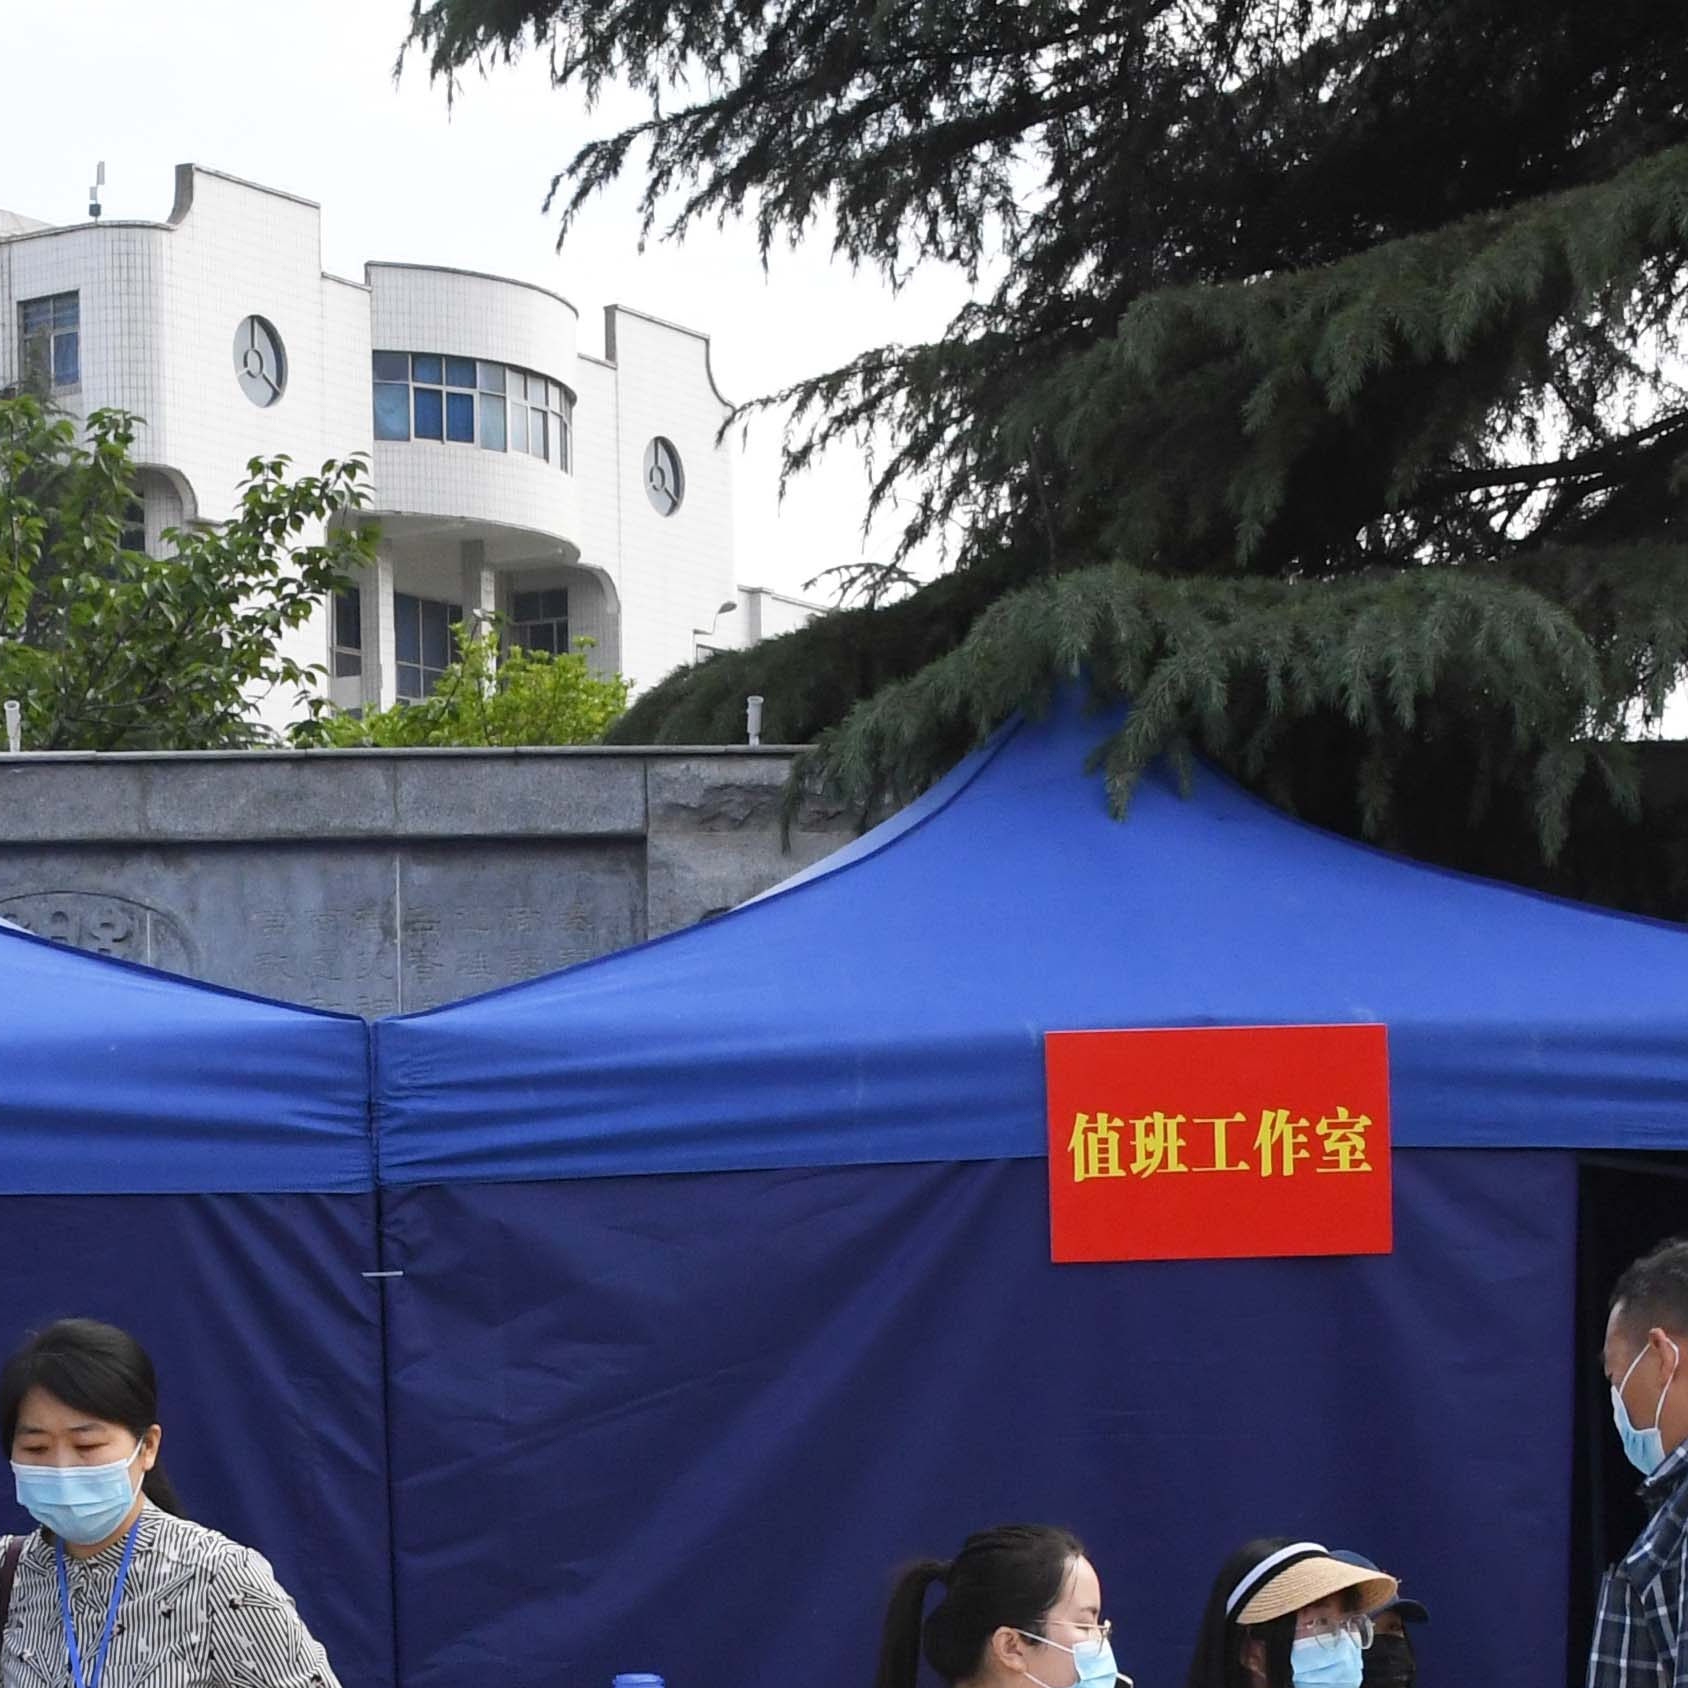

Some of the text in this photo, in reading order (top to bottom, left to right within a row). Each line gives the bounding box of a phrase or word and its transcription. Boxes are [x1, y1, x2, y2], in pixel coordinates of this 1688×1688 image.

[1067, 1105, 1373, 1183] 值班工作室
